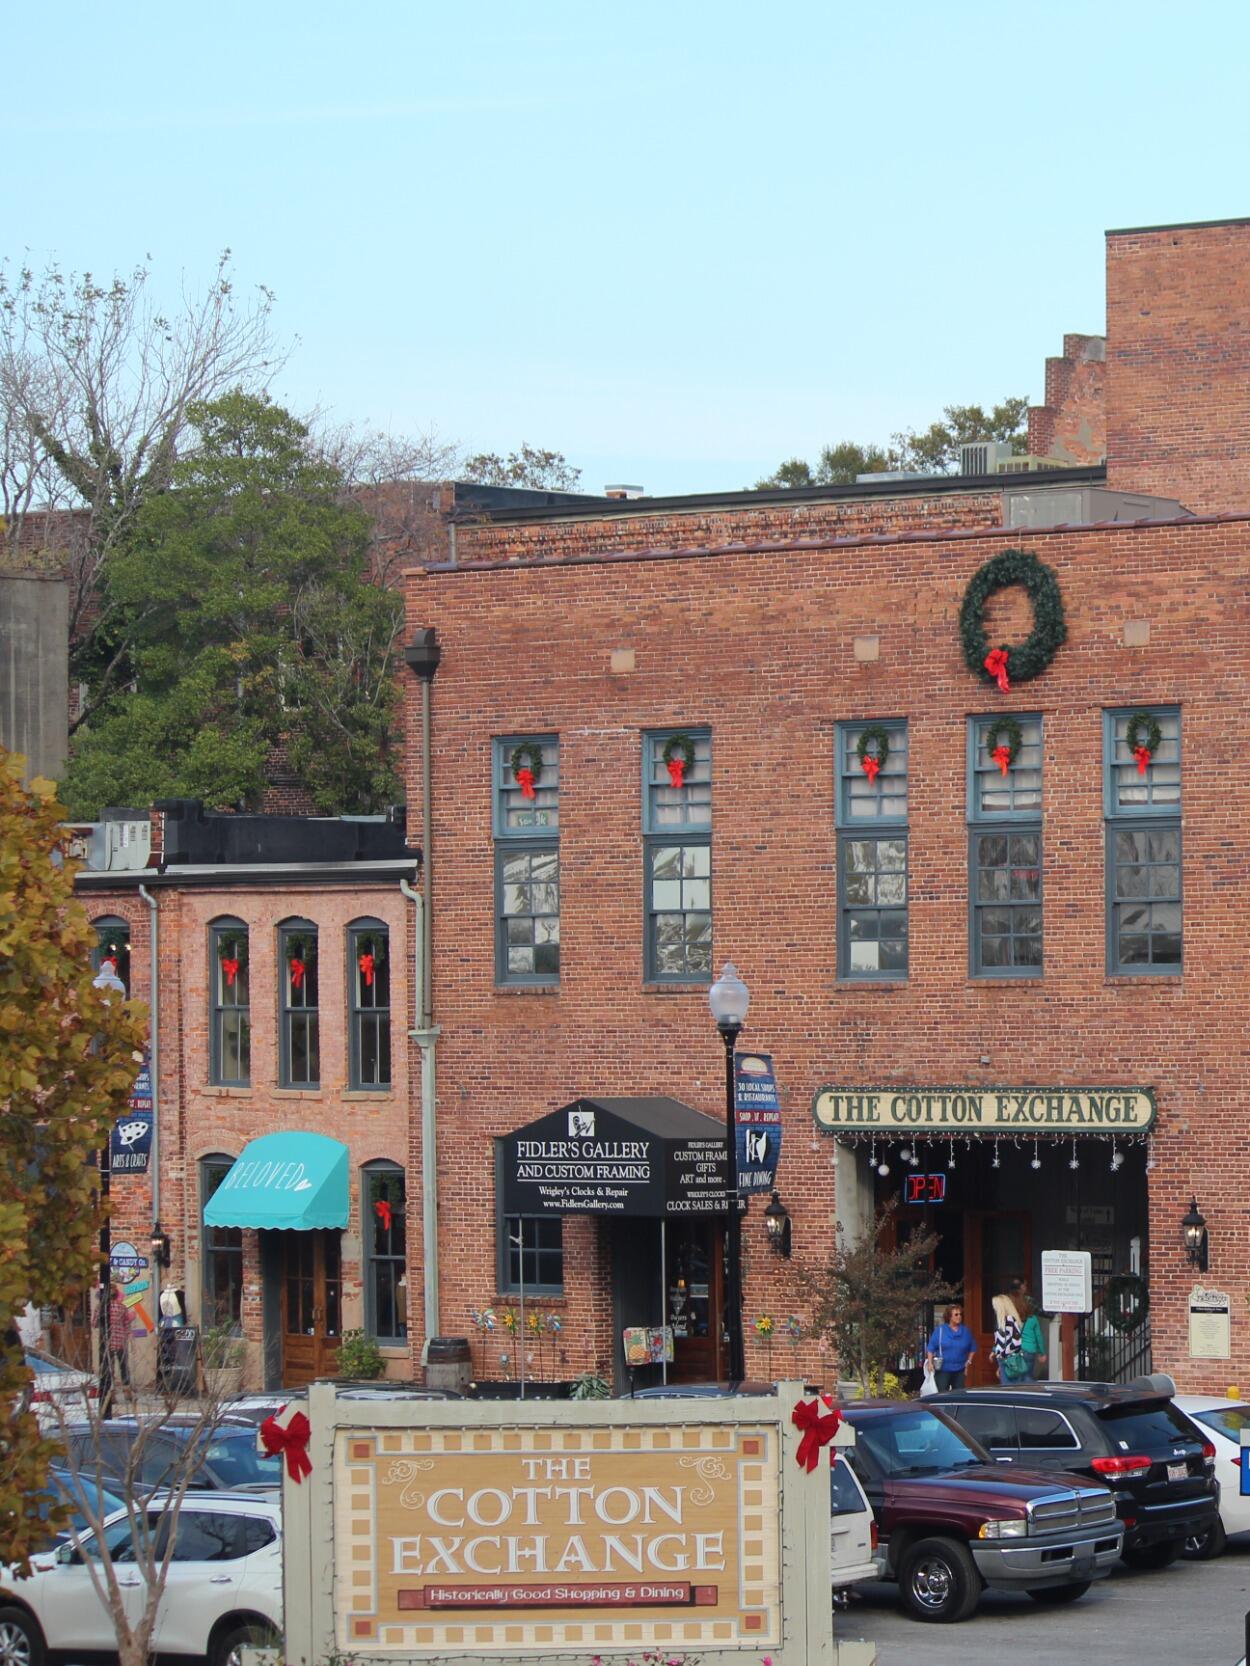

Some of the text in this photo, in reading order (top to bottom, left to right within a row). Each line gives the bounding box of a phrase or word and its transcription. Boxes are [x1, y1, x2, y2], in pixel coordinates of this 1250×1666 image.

[829, 1095, 1139, 1124] THE COTTON EXCHANGE
[517, 1141, 650, 1159] FIDLER'S GALLERY
[674, 1151, 704, 1161] CUSTOM
[112, 1153, 148, 1168] ARTS & CRAFTS
[696, 1162, 717, 1173] GIFTS
[225, 1160, 304, 1190] BELOVED
[517, 1165, 650, 1179] AND CUSTOM FRAMING
[680, 1174, 695, 1184] ART
[696, 1174, 706, 1183] and
[739, 1170, 773, 1187] FINE DINING
[539, 1186, 628, 1198] Wrigley's Clocks & Repair
[908, 1176, 944, 1200] OPEN
[543, 1199, 624, 1210] www.FidlersGallery.com
[667, 1201, 691, 1211] CLOCK
[692, 1200, 713, 1210] SALES
[714, 1200, 720, 1210] &
[119, 1258, 137, 1266] CANDY
[522, 1456, 592, 1481] THE
[426, 1484, 687, 1529] COTTON
[387, 1529, 726, 1577] EXCHANGE
[430, 1586, 684, 1602] Historically Good Shopping & Dining
